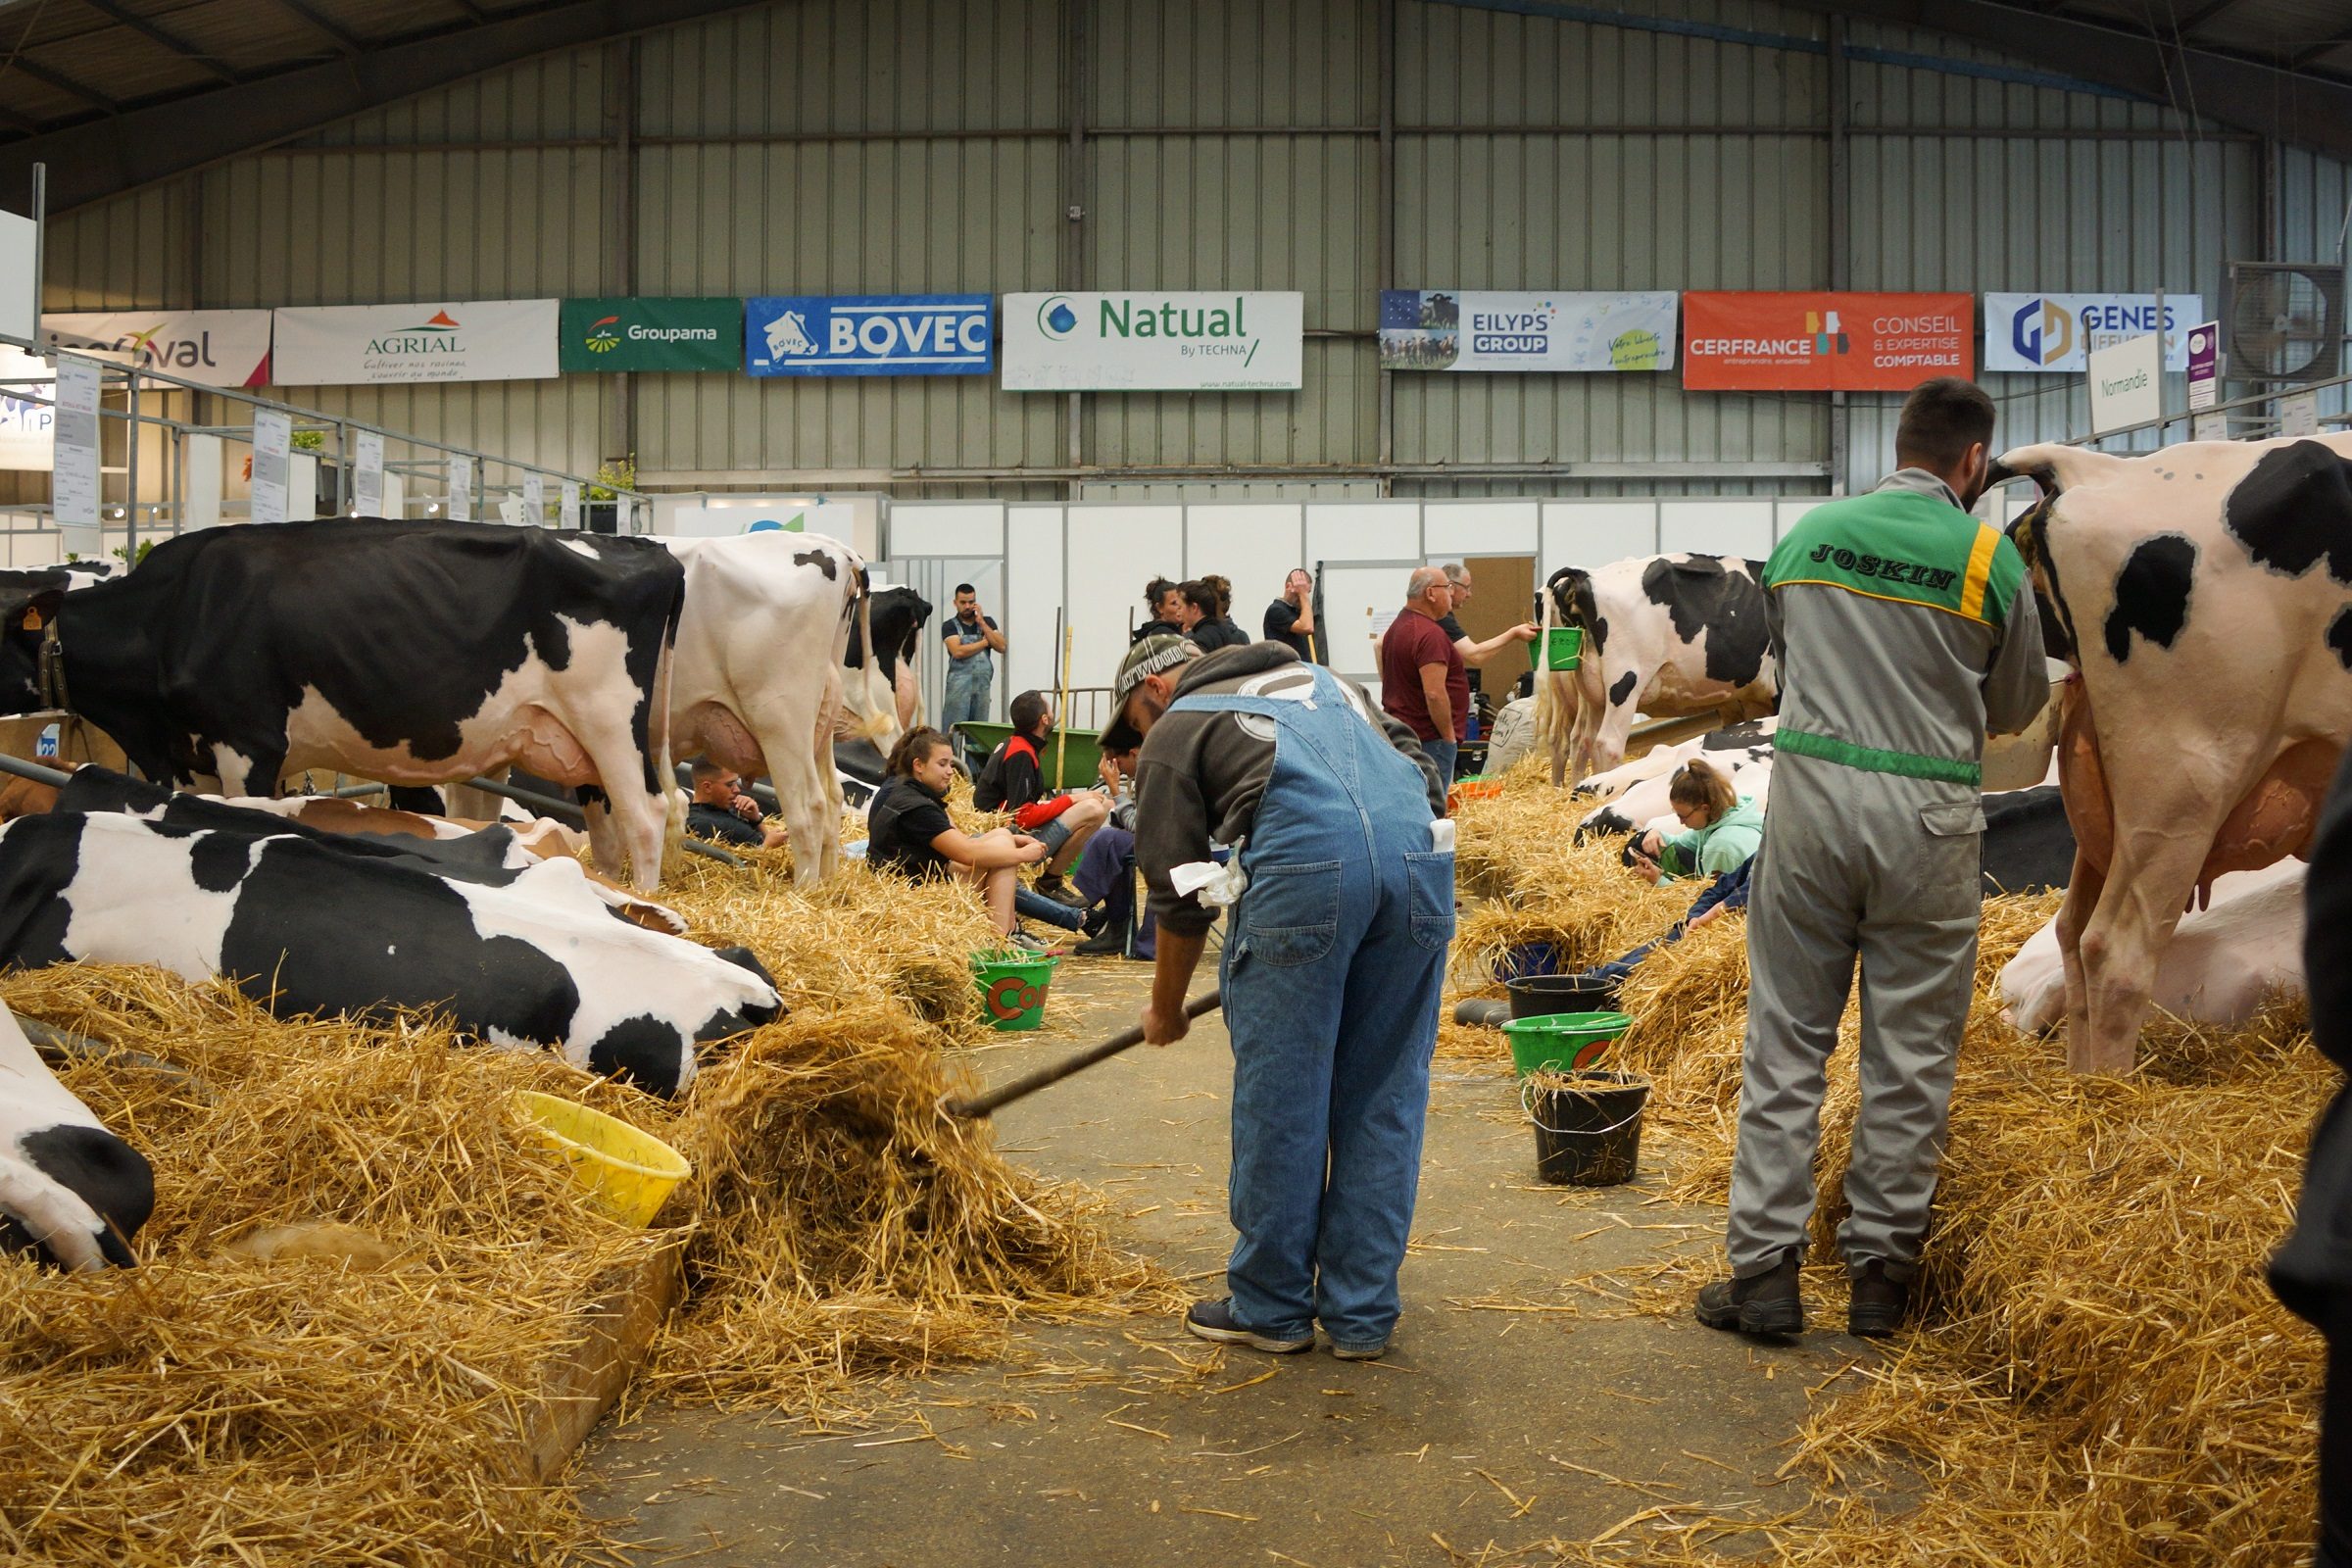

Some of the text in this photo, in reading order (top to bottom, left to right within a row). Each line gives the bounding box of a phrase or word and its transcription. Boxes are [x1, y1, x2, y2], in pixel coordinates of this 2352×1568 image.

[1100, 296, 1247, 338] Natual
[1473, 314, 1548, 331] EILYPS
[1873, 317, 1962, 334] CONSEIL
[2080, 305, 2175, 331] GENES
[628, 324, 717, 343] Groupama
[829, 315, 987, 355] BOVEC
[365, 336, 466, 355] AGRIAL
[1181, 345, 1247, 357] By TECHNA
[1476, 337, 1546, 352] GROUP
[1690, 339, 1811, 356] CERFRANCE
[1874, 337, 1959, 351] & EXPERTISE
[1873, 354, 1960, 368] COMPTABLE
[2101, 369, 2148, 397] Normandie
[1810, 544, 1957, 591] JOSKIN
